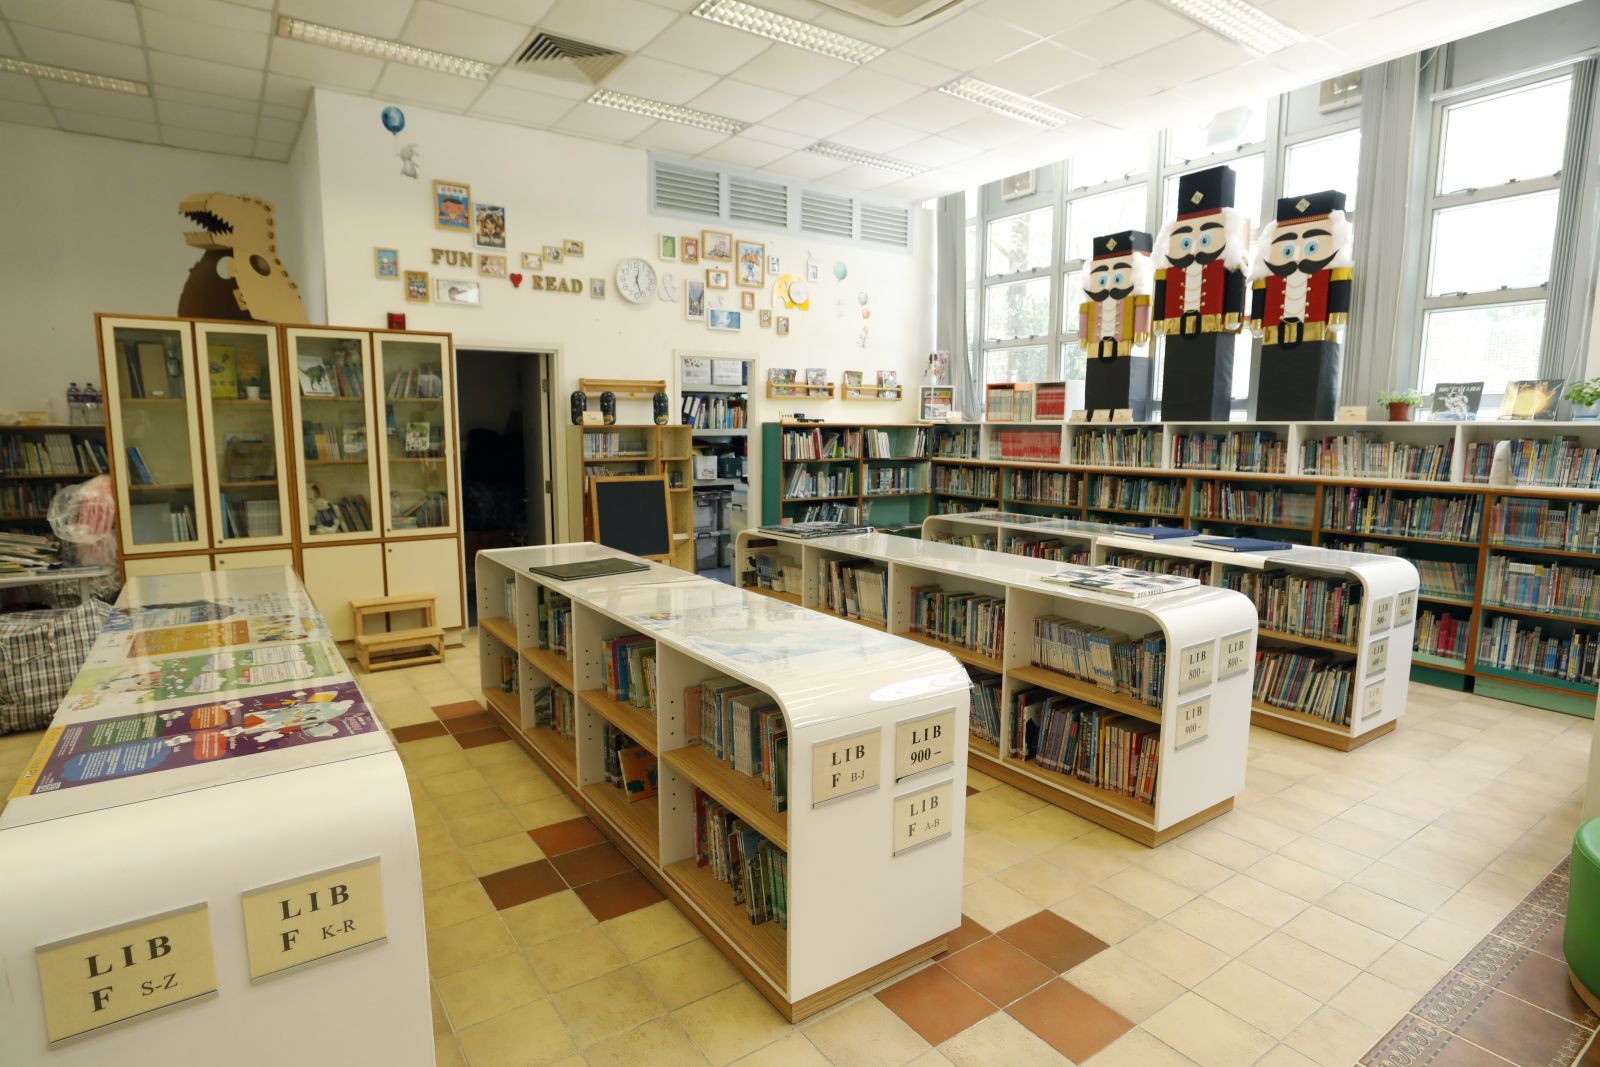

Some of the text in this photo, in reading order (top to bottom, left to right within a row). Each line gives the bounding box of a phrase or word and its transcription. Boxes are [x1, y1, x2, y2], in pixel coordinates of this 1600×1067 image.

[431, 248, 473, 268] FUN
[532, 274, 584, 294] READ
[1189, 651, 1206, 664] LIB
[1228, 641, 1244, 654] LIB
[1186, 706, 1202, 720] LIB
[912, 724, 942, 745] LIB
[831, 744, 865, 766] LIB
[831, 770, 865, 788] F B-J
[910, 795, 939, 817] LIB
[908, 818, 940, 837] F A-B
[279, 884, 350, 921] LIB
[280, 919, 356, 953] F K-R
[84, 934, 172, 979] LIB
[89, 973, 178, 1013] F S-Z
